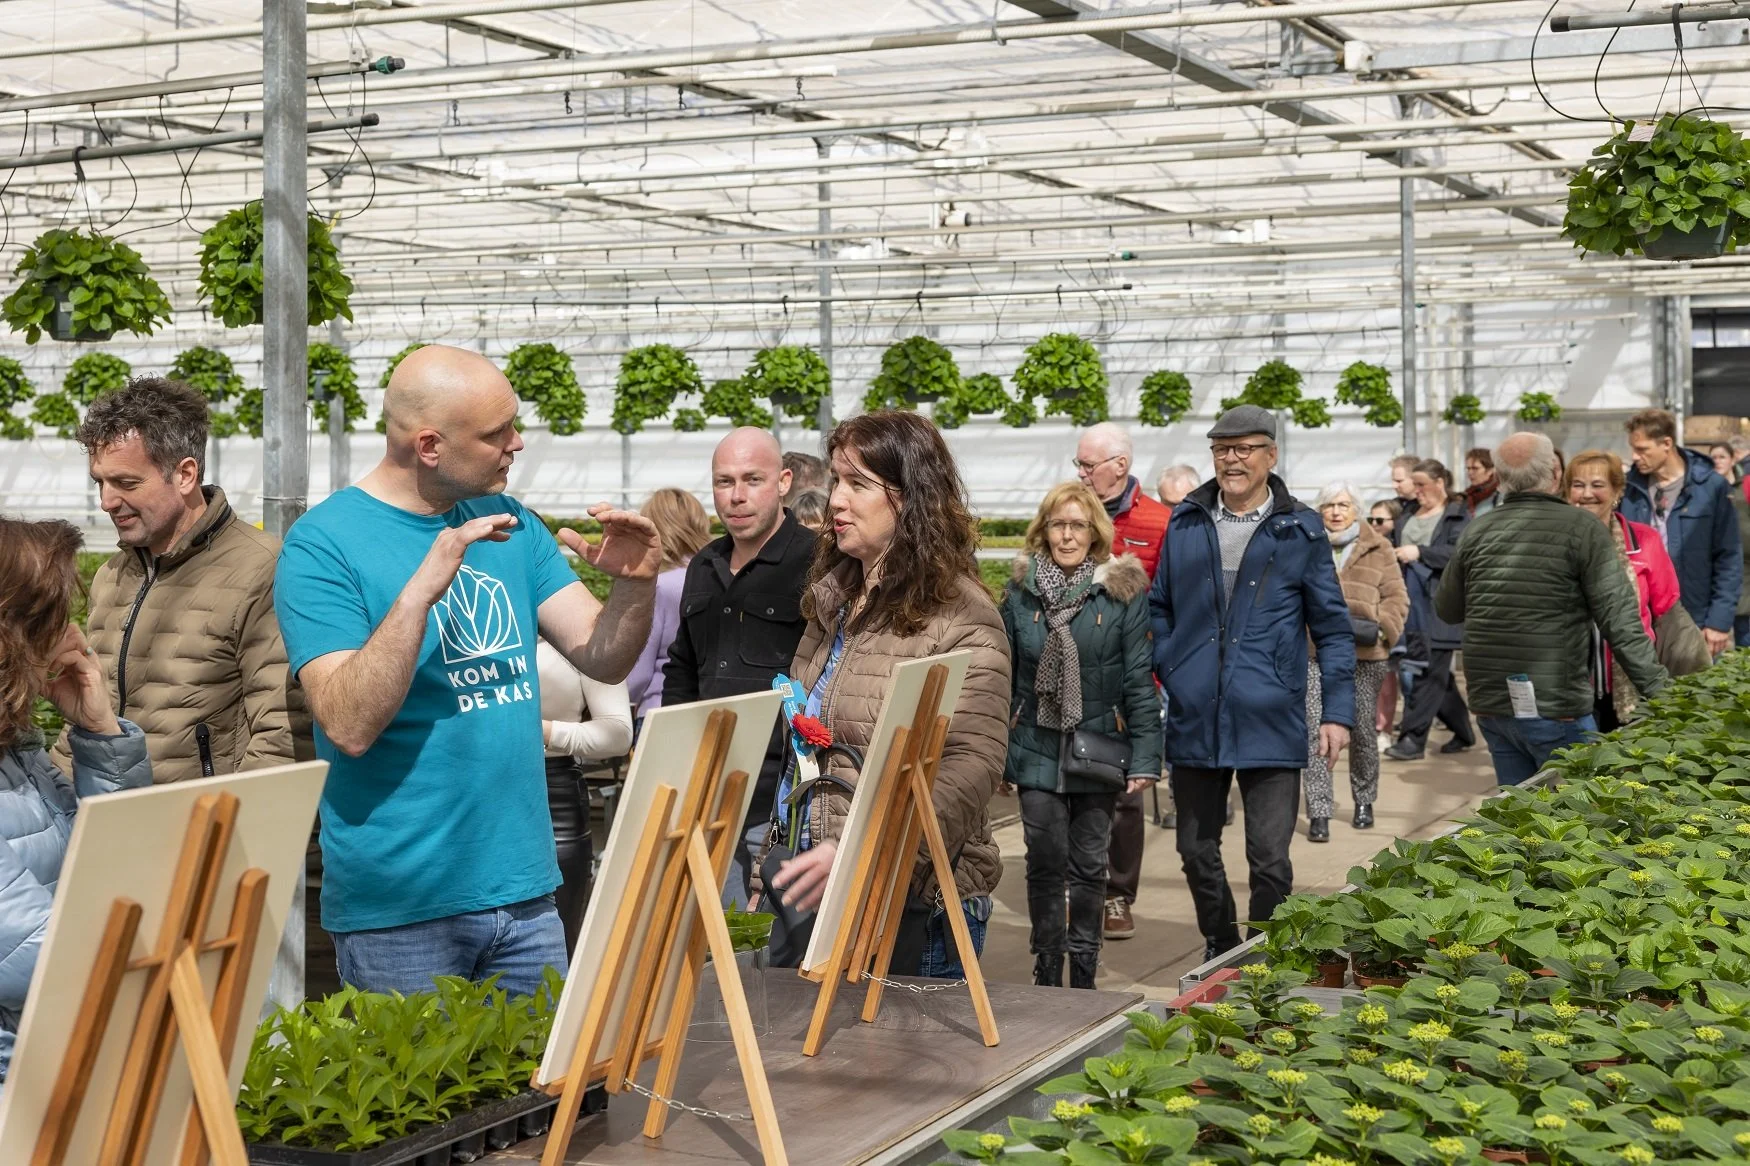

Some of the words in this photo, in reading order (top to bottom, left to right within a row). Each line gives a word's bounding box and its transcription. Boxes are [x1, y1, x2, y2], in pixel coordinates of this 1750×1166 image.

[448, 662, 499, 687] KOM
[508, 655, 527, 675] IN
[458, 692, 488, 713] DE
[494, 681, 533, 705] KAS
